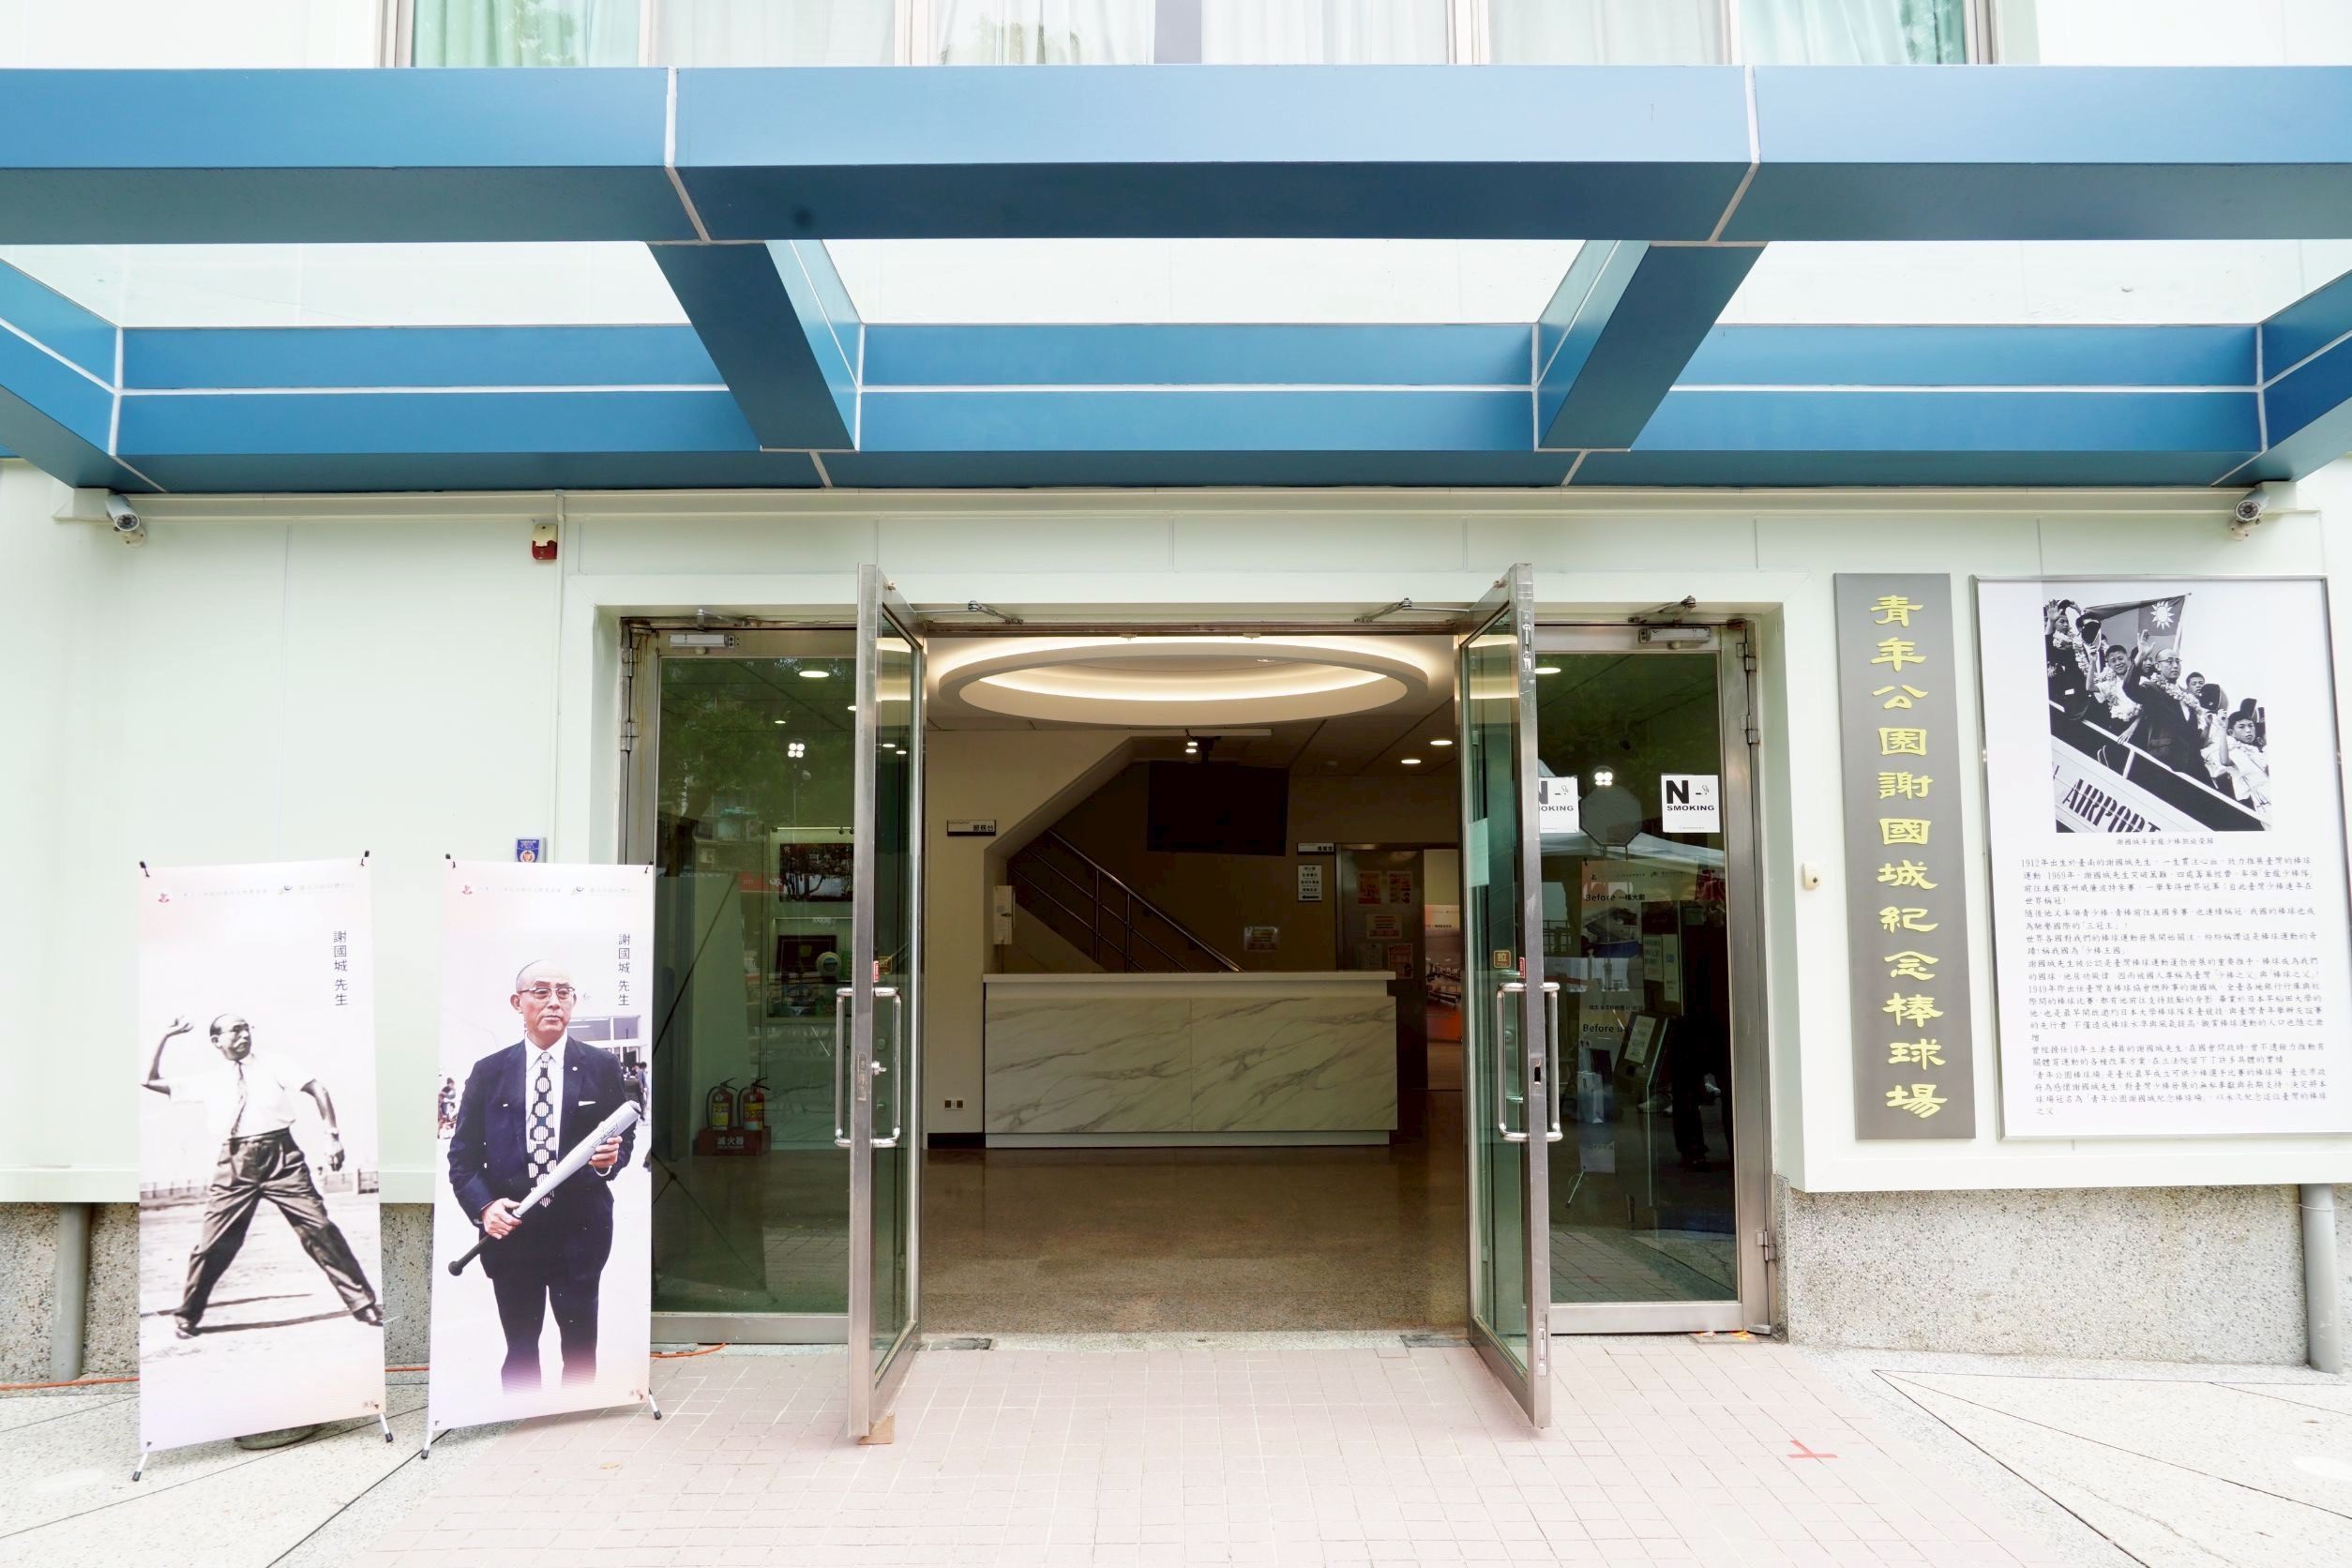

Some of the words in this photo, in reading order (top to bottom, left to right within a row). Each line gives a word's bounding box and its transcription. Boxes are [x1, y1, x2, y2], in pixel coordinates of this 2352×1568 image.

[1869, 595, 1948, 1121] 青年公園謝國城紀念棒球場
[333, 930, 347, 972] 謝國城
[618, 933, 630, 973] 謝國城
[335, 978, 348, 1006] 先生
[618, 979, 630, 1006] 先生
[1582, 1023, 1614, 1033] Before
